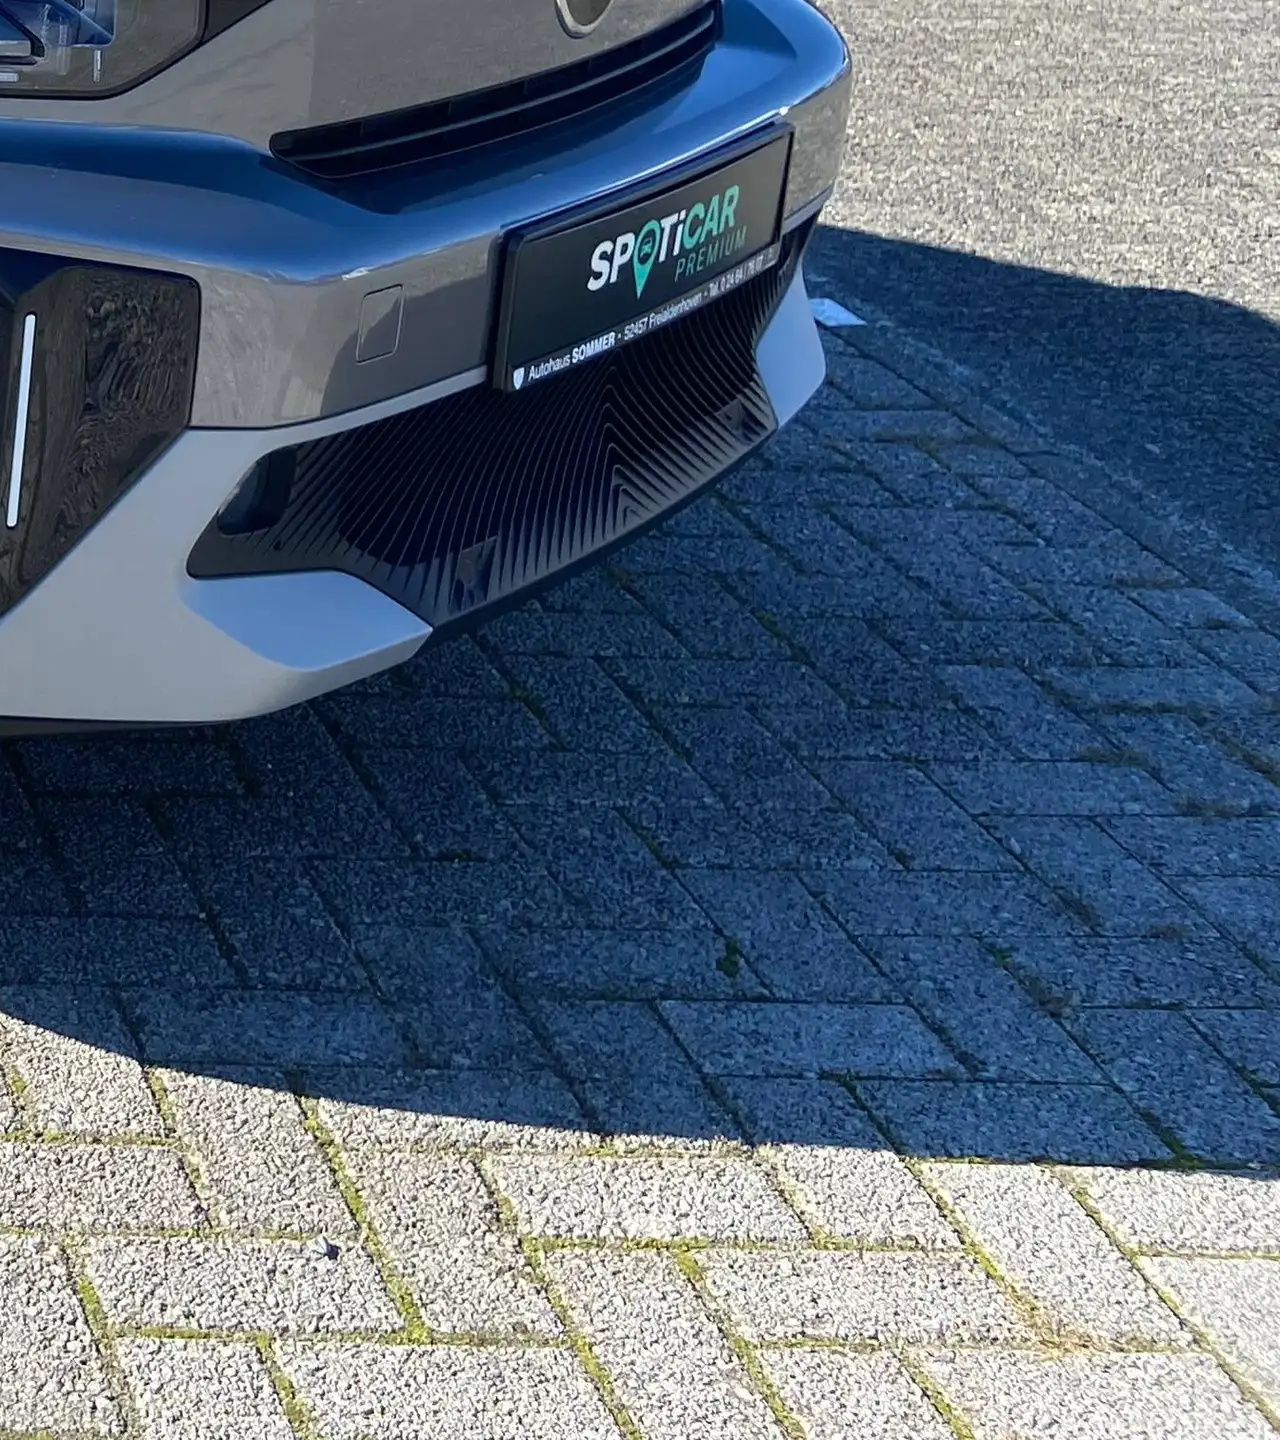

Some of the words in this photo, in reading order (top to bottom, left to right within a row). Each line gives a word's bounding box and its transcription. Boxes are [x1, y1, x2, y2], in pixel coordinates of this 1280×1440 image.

[675, 225, 747, 282] PREMIUM
[528, 355, 570, 382] Autohaus
[572, 331, 615, 363] SOMMER
[624, 316, 648, 340] 52457
